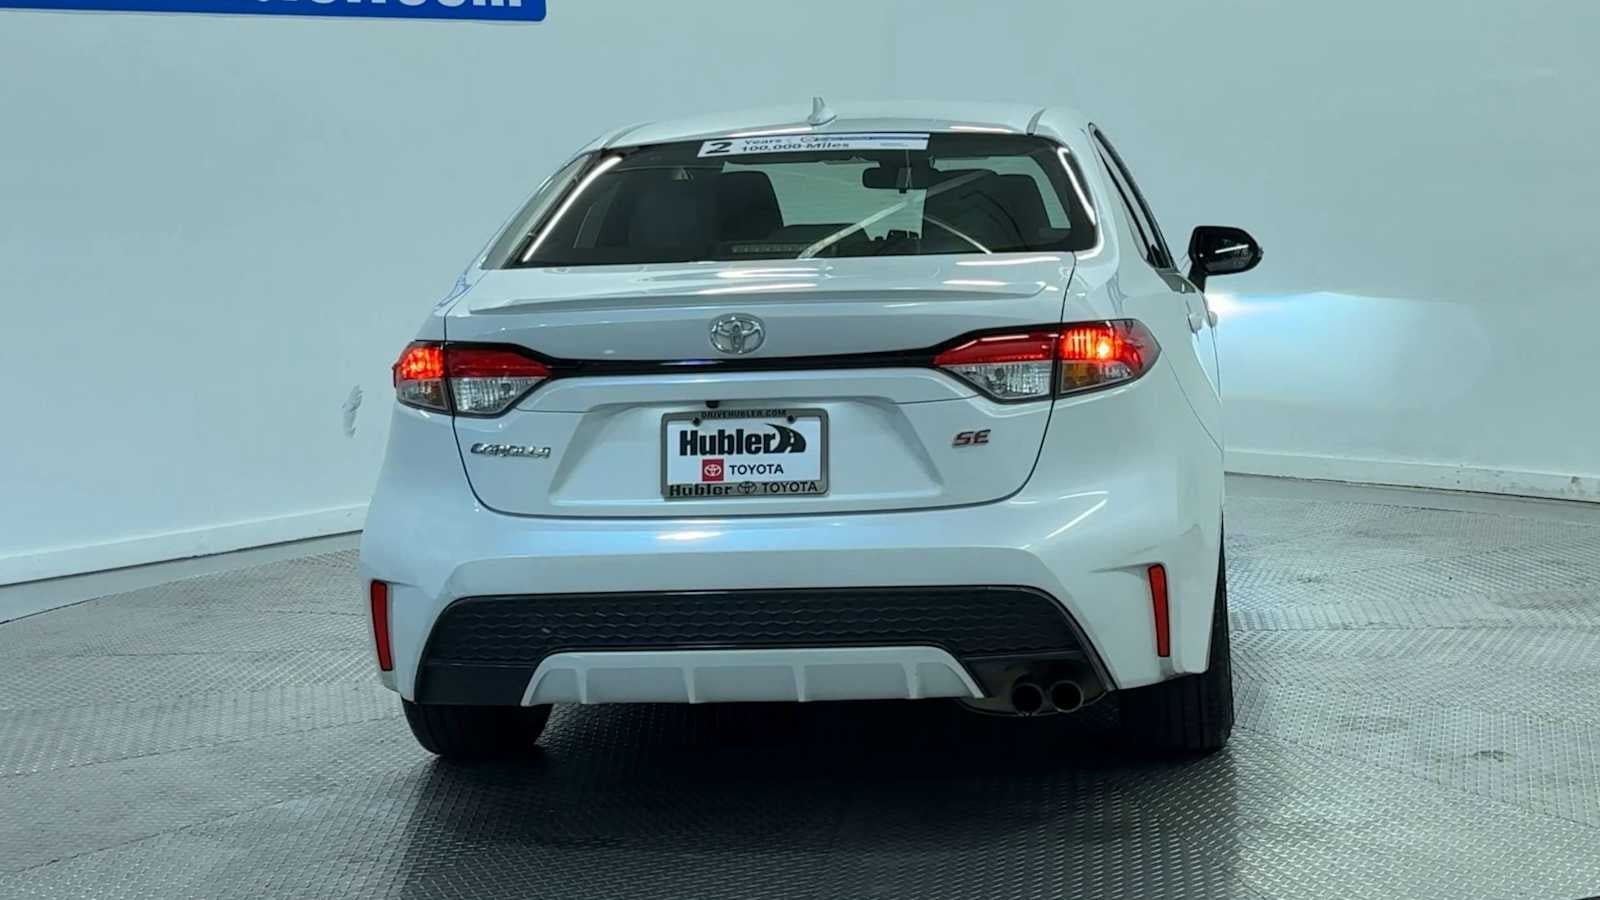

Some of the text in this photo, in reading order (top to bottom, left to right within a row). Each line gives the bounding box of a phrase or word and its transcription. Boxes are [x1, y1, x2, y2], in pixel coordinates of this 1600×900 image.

[704, 141, 733, 155] 2
[679, 429, 776, 456] Hubler
[952, 429, 992, 447] SE
[729, 464, 784, 475] TOYOTA
[669, 481, 818, 497] Hubler TOYOTA
